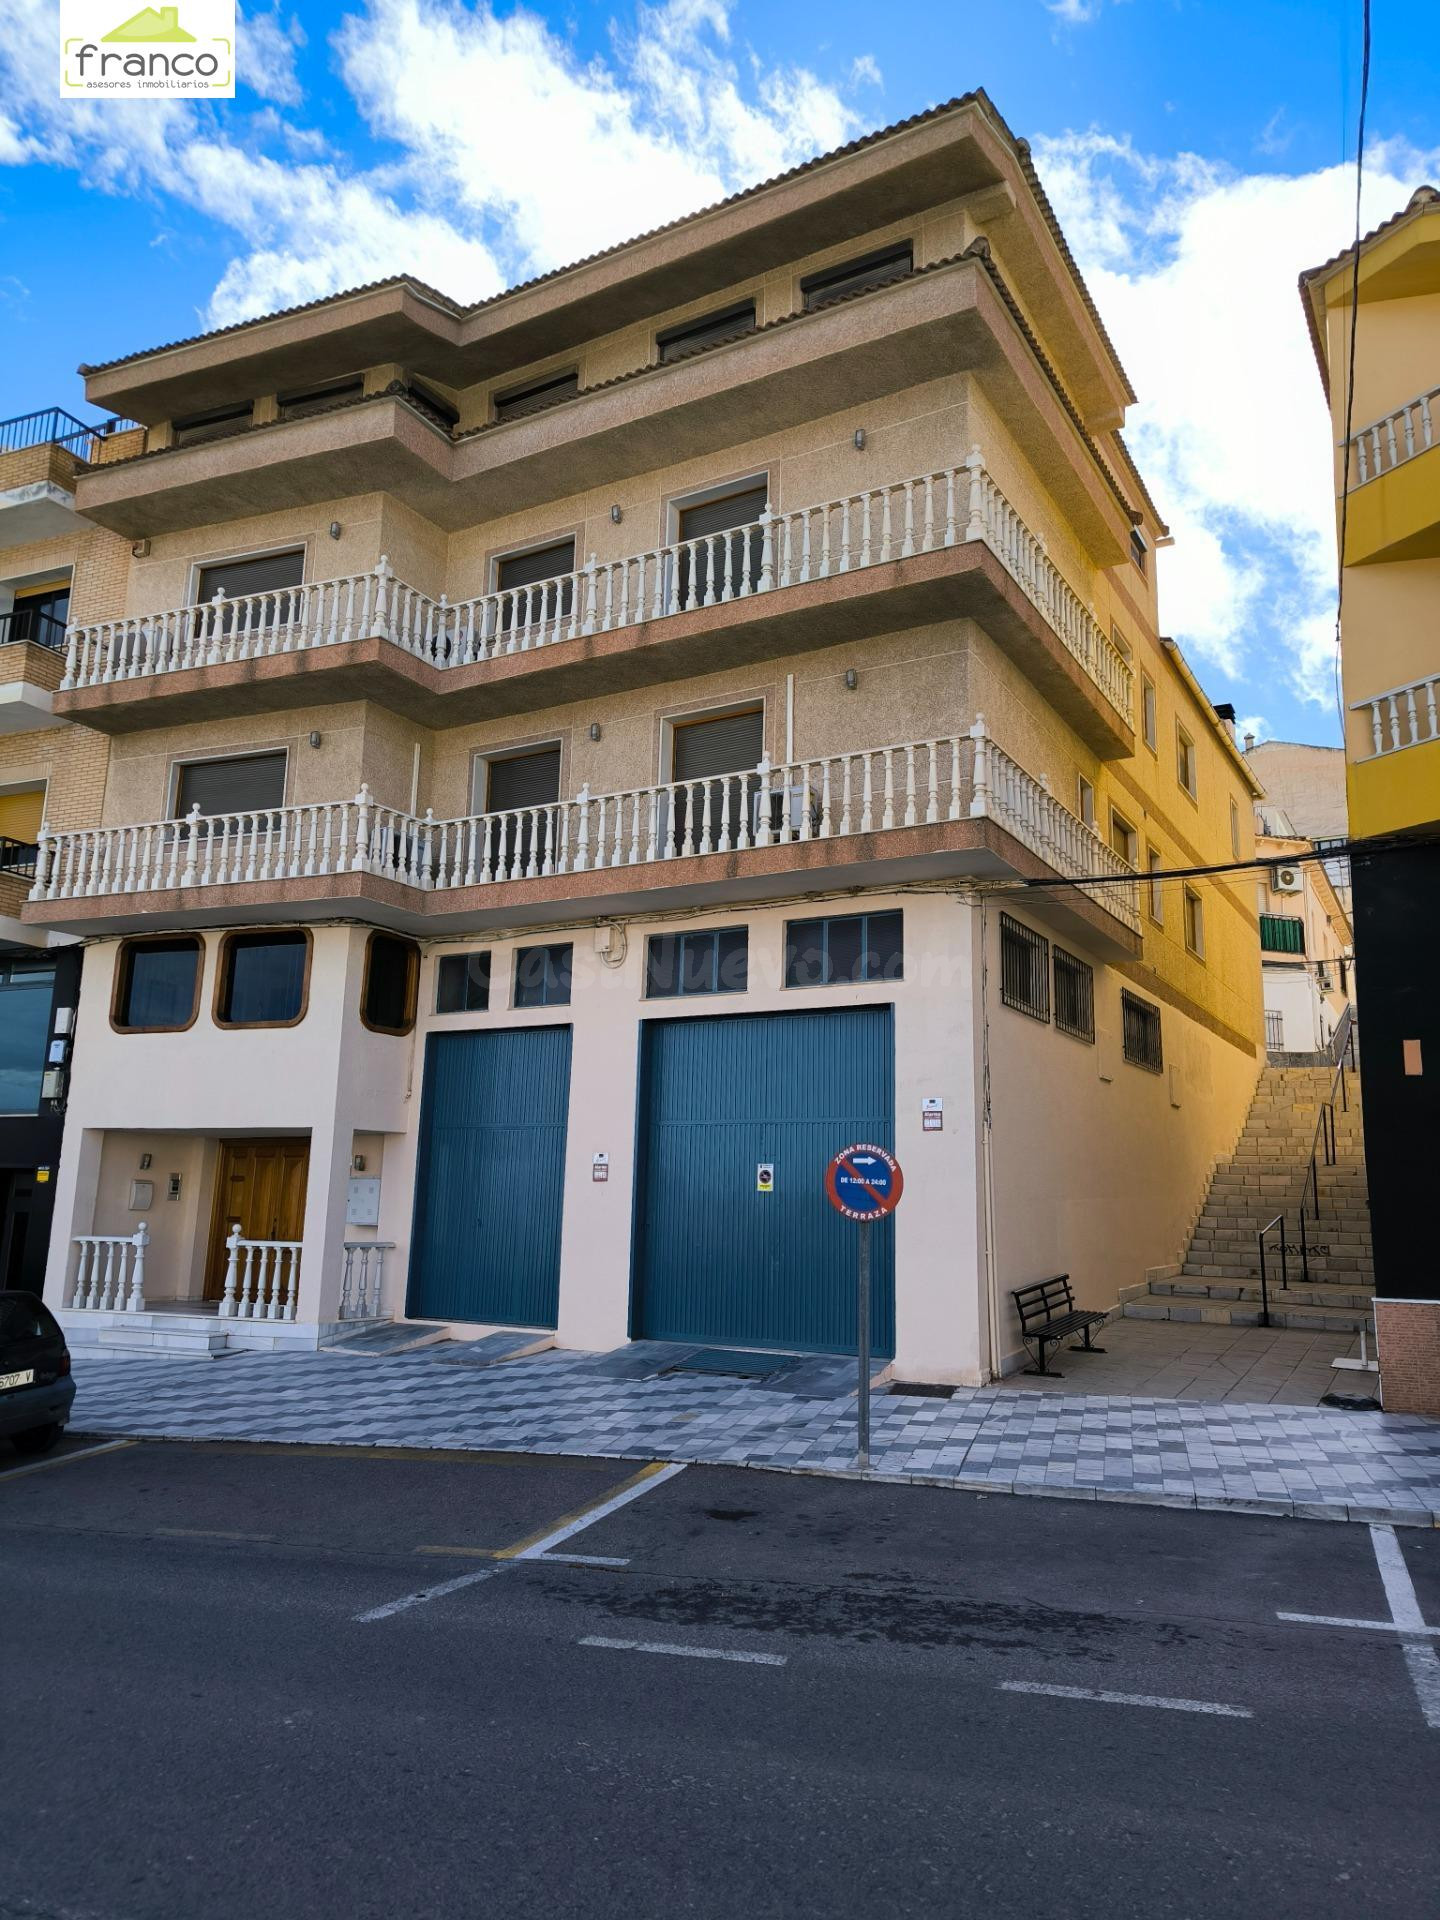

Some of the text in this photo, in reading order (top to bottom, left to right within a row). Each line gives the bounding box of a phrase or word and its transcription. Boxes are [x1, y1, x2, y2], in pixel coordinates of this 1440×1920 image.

[835, 1143, 897, 1173] ZONA RESERVADA
[840, 1205, 888, 1220] TERRAZA
